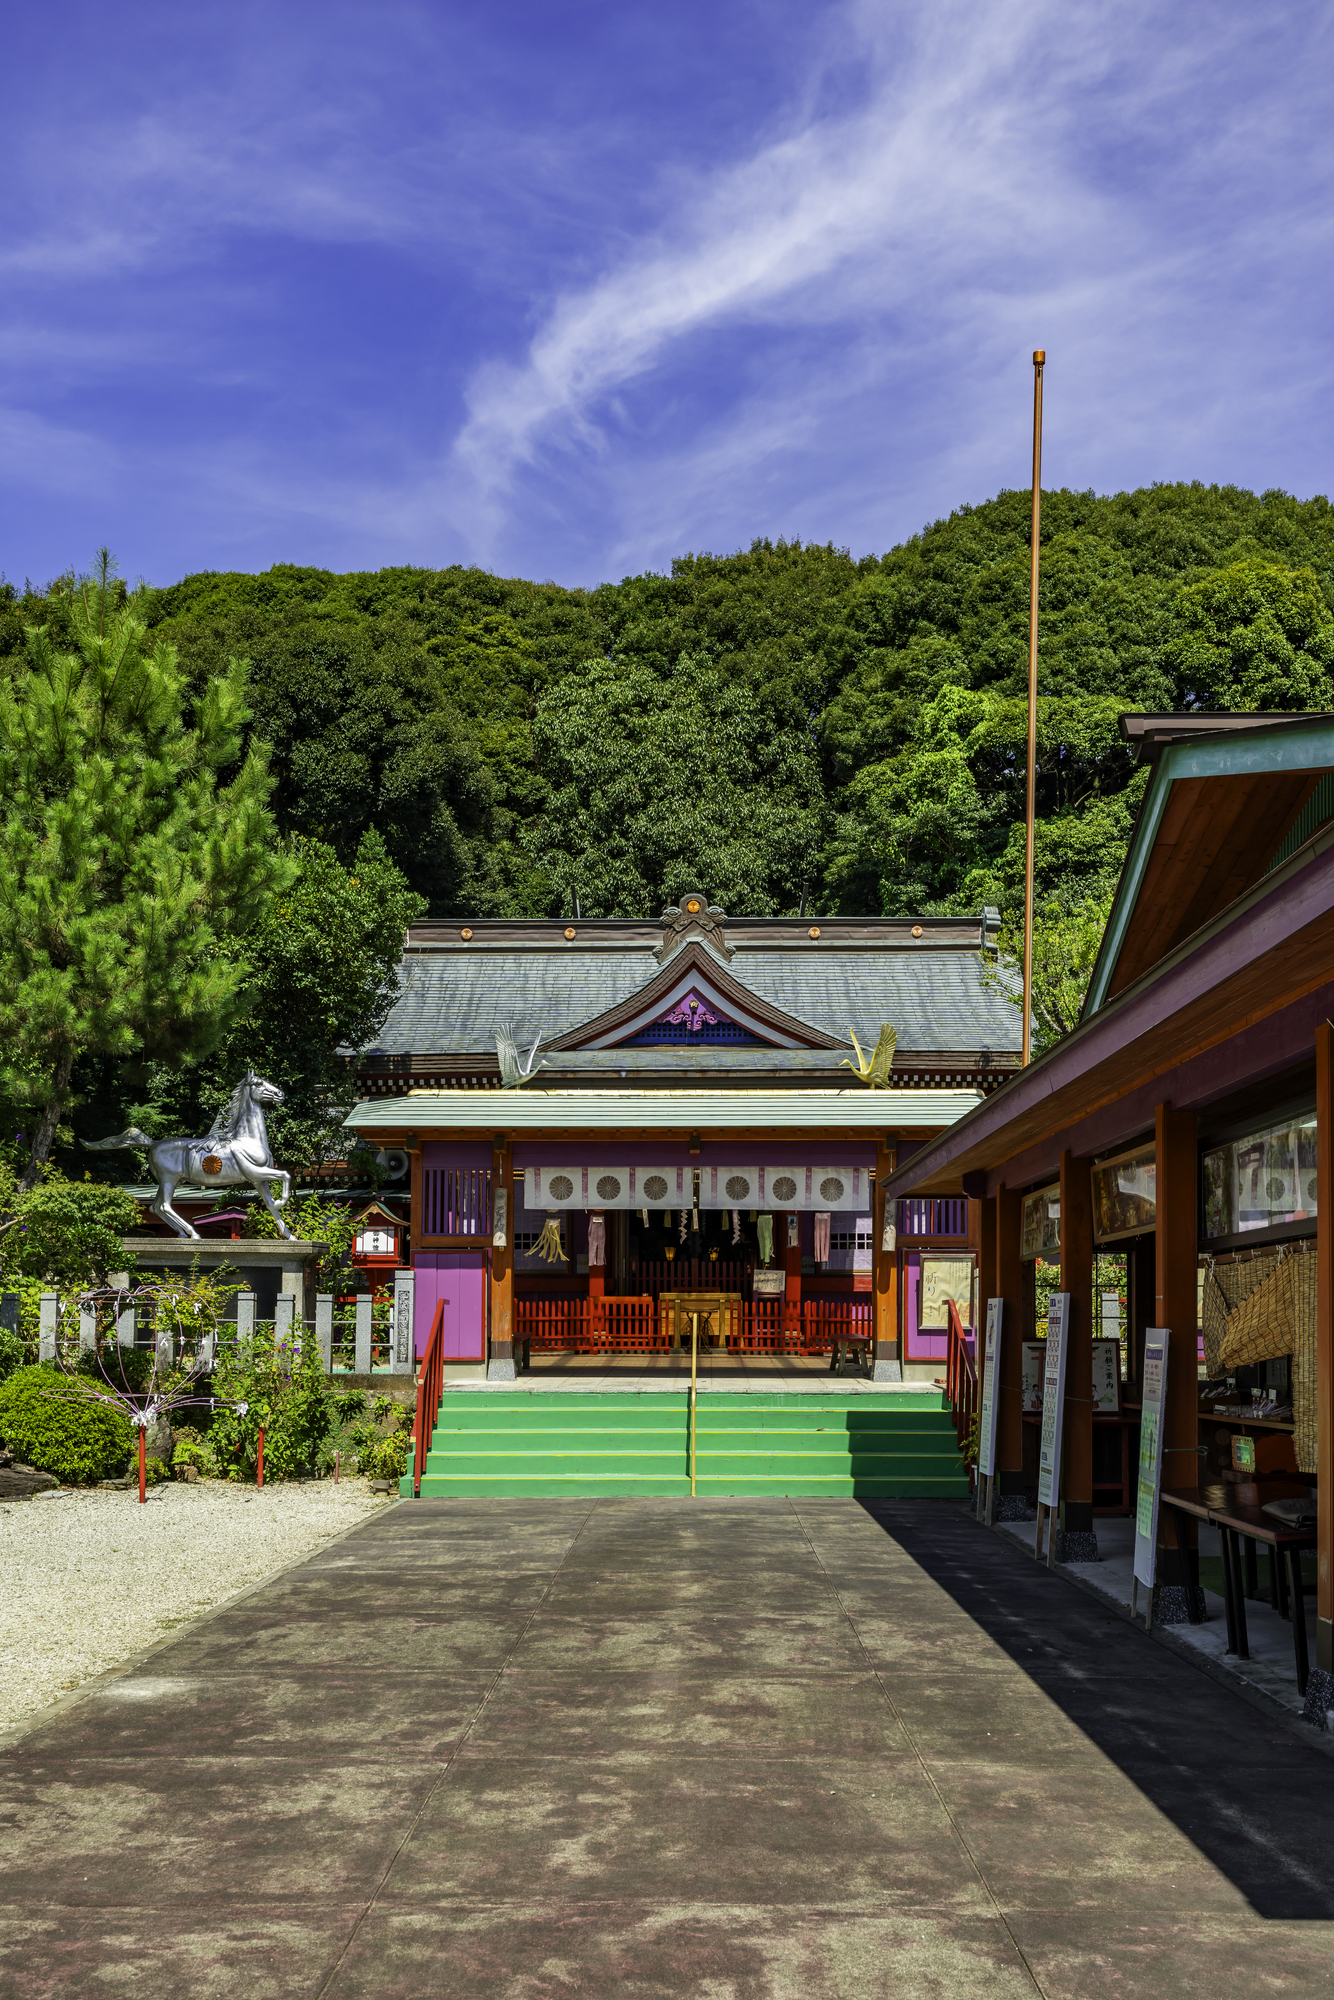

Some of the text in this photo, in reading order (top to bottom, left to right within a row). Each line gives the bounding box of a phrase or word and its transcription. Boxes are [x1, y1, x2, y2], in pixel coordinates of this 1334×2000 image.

[925, 1271, 939, 1297] 祈り
[1104, 1347, 1114, 1390] 祈願ご案内
